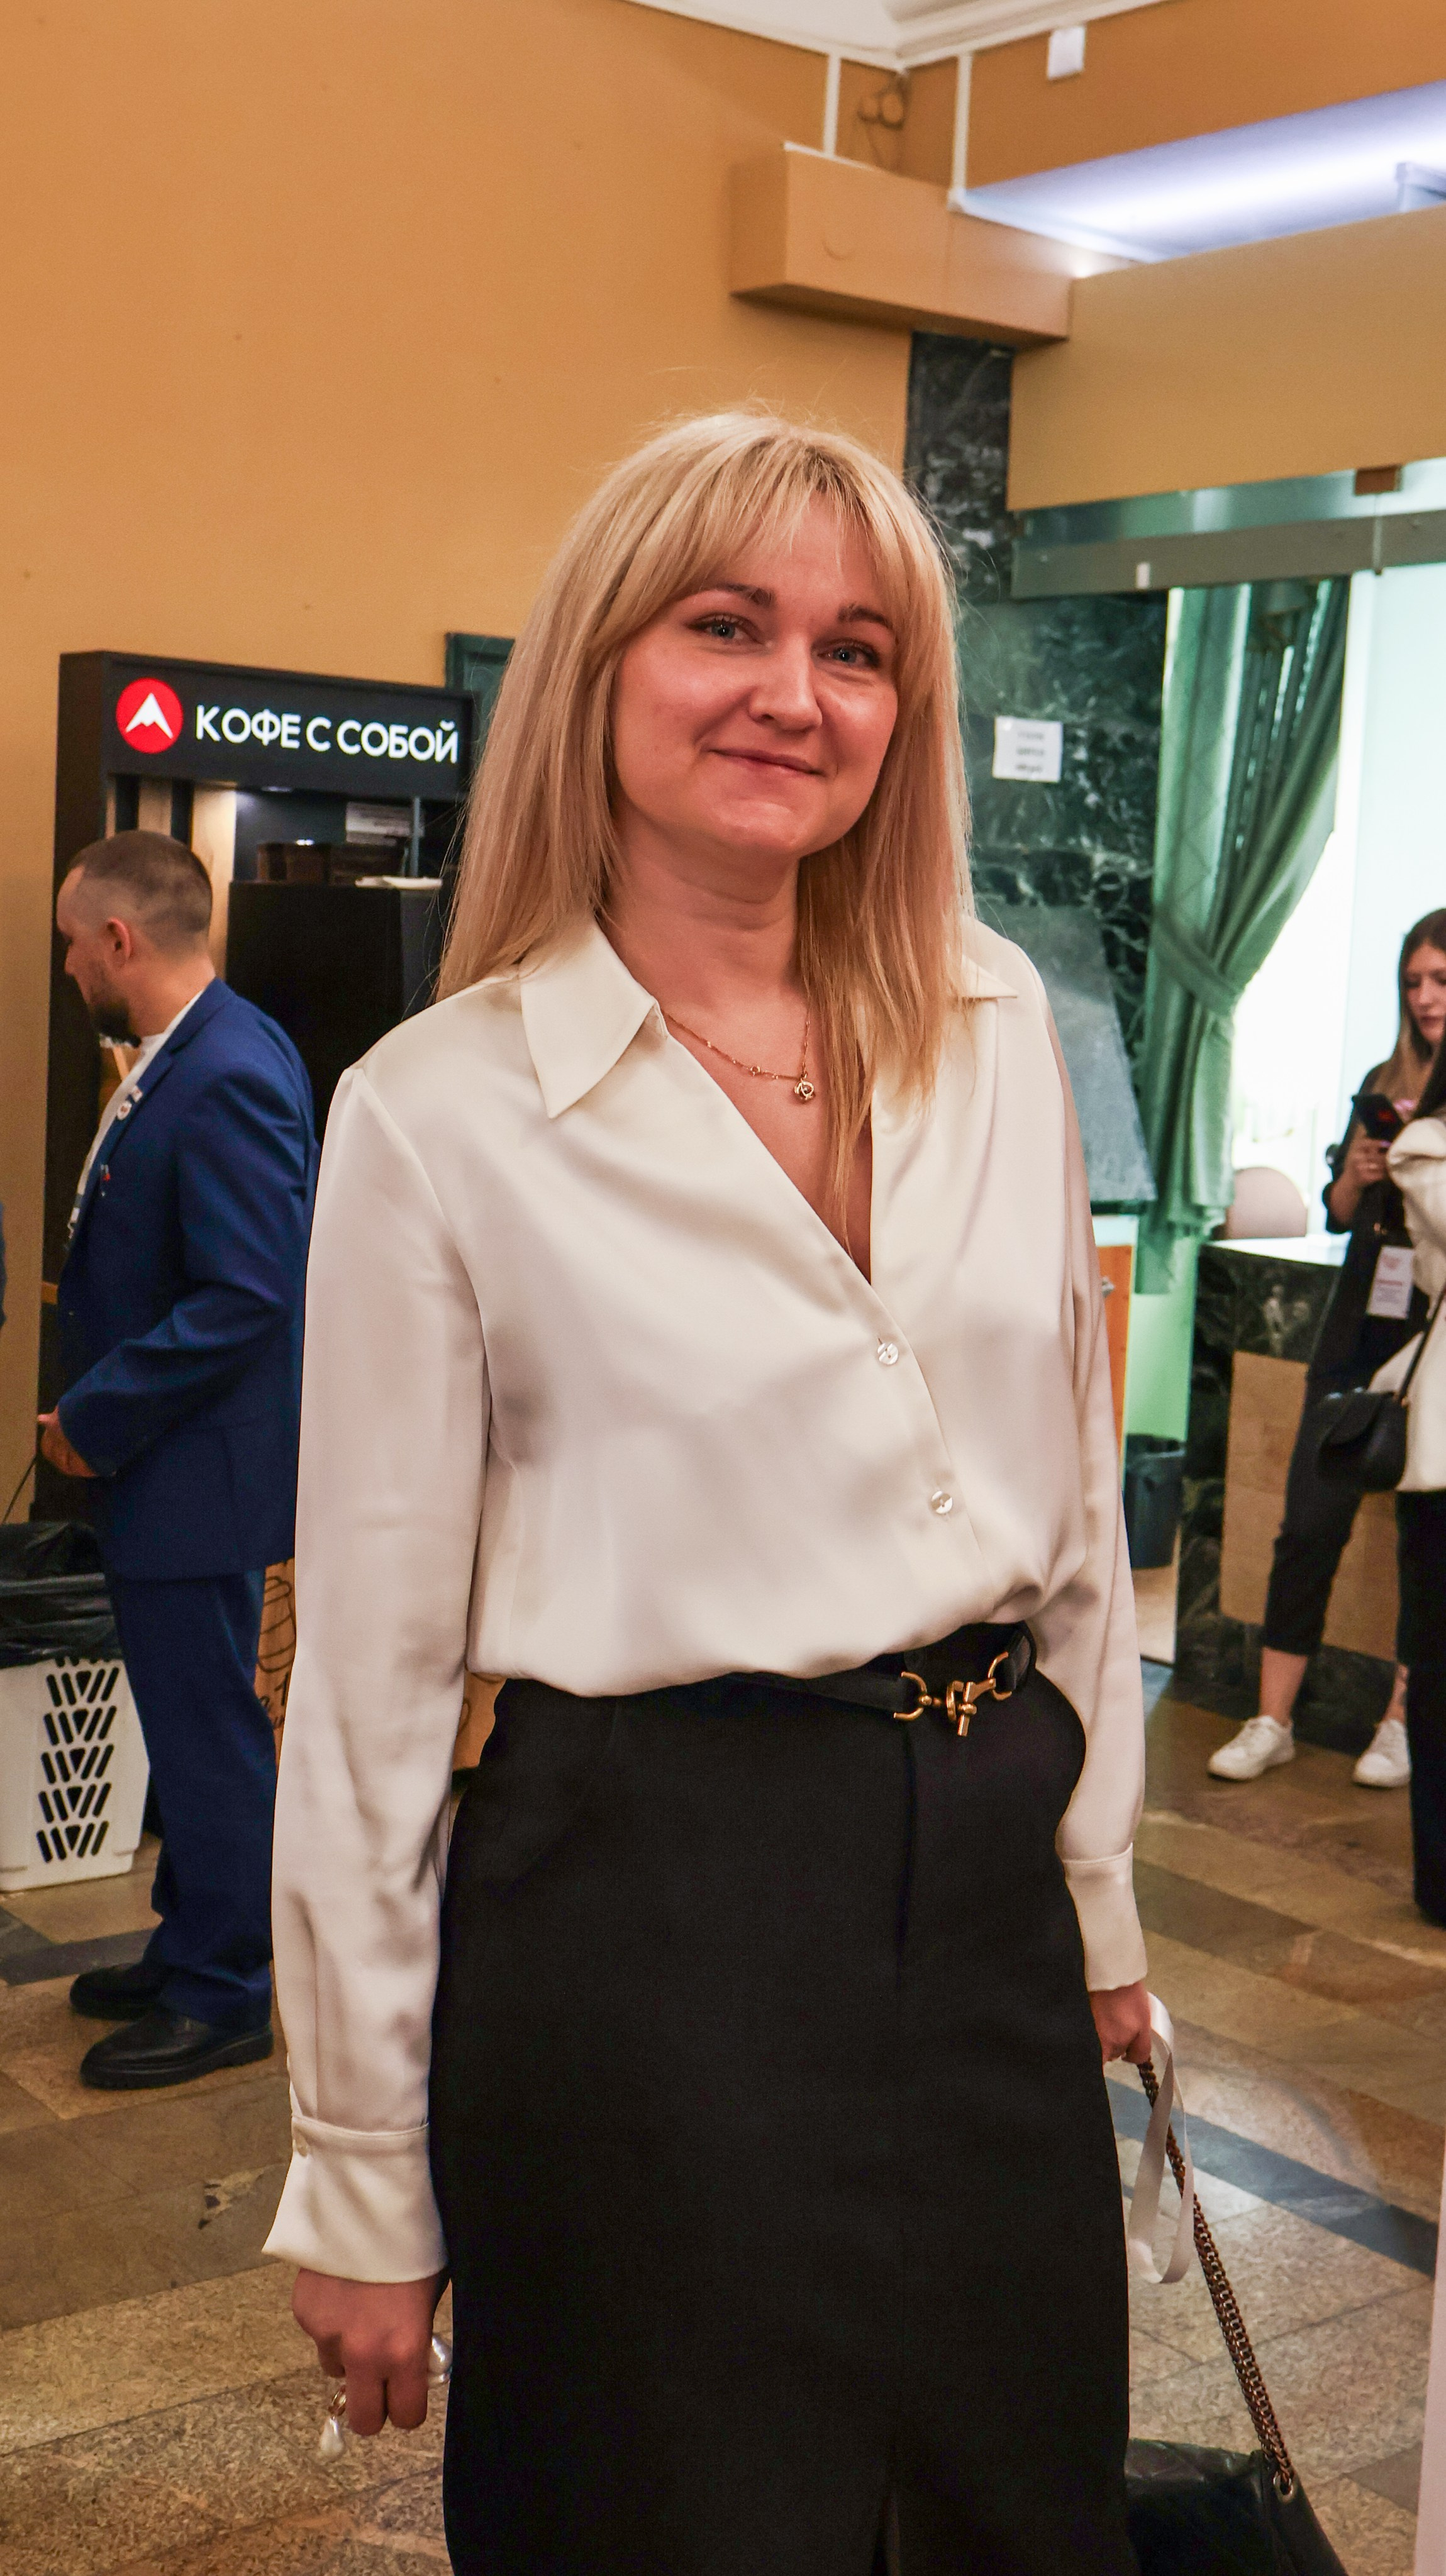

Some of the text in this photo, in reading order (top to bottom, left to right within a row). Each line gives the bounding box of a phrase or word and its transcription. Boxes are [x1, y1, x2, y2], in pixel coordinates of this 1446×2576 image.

[196, 704, 459, 764] КОФЕ С СОБОЙ
